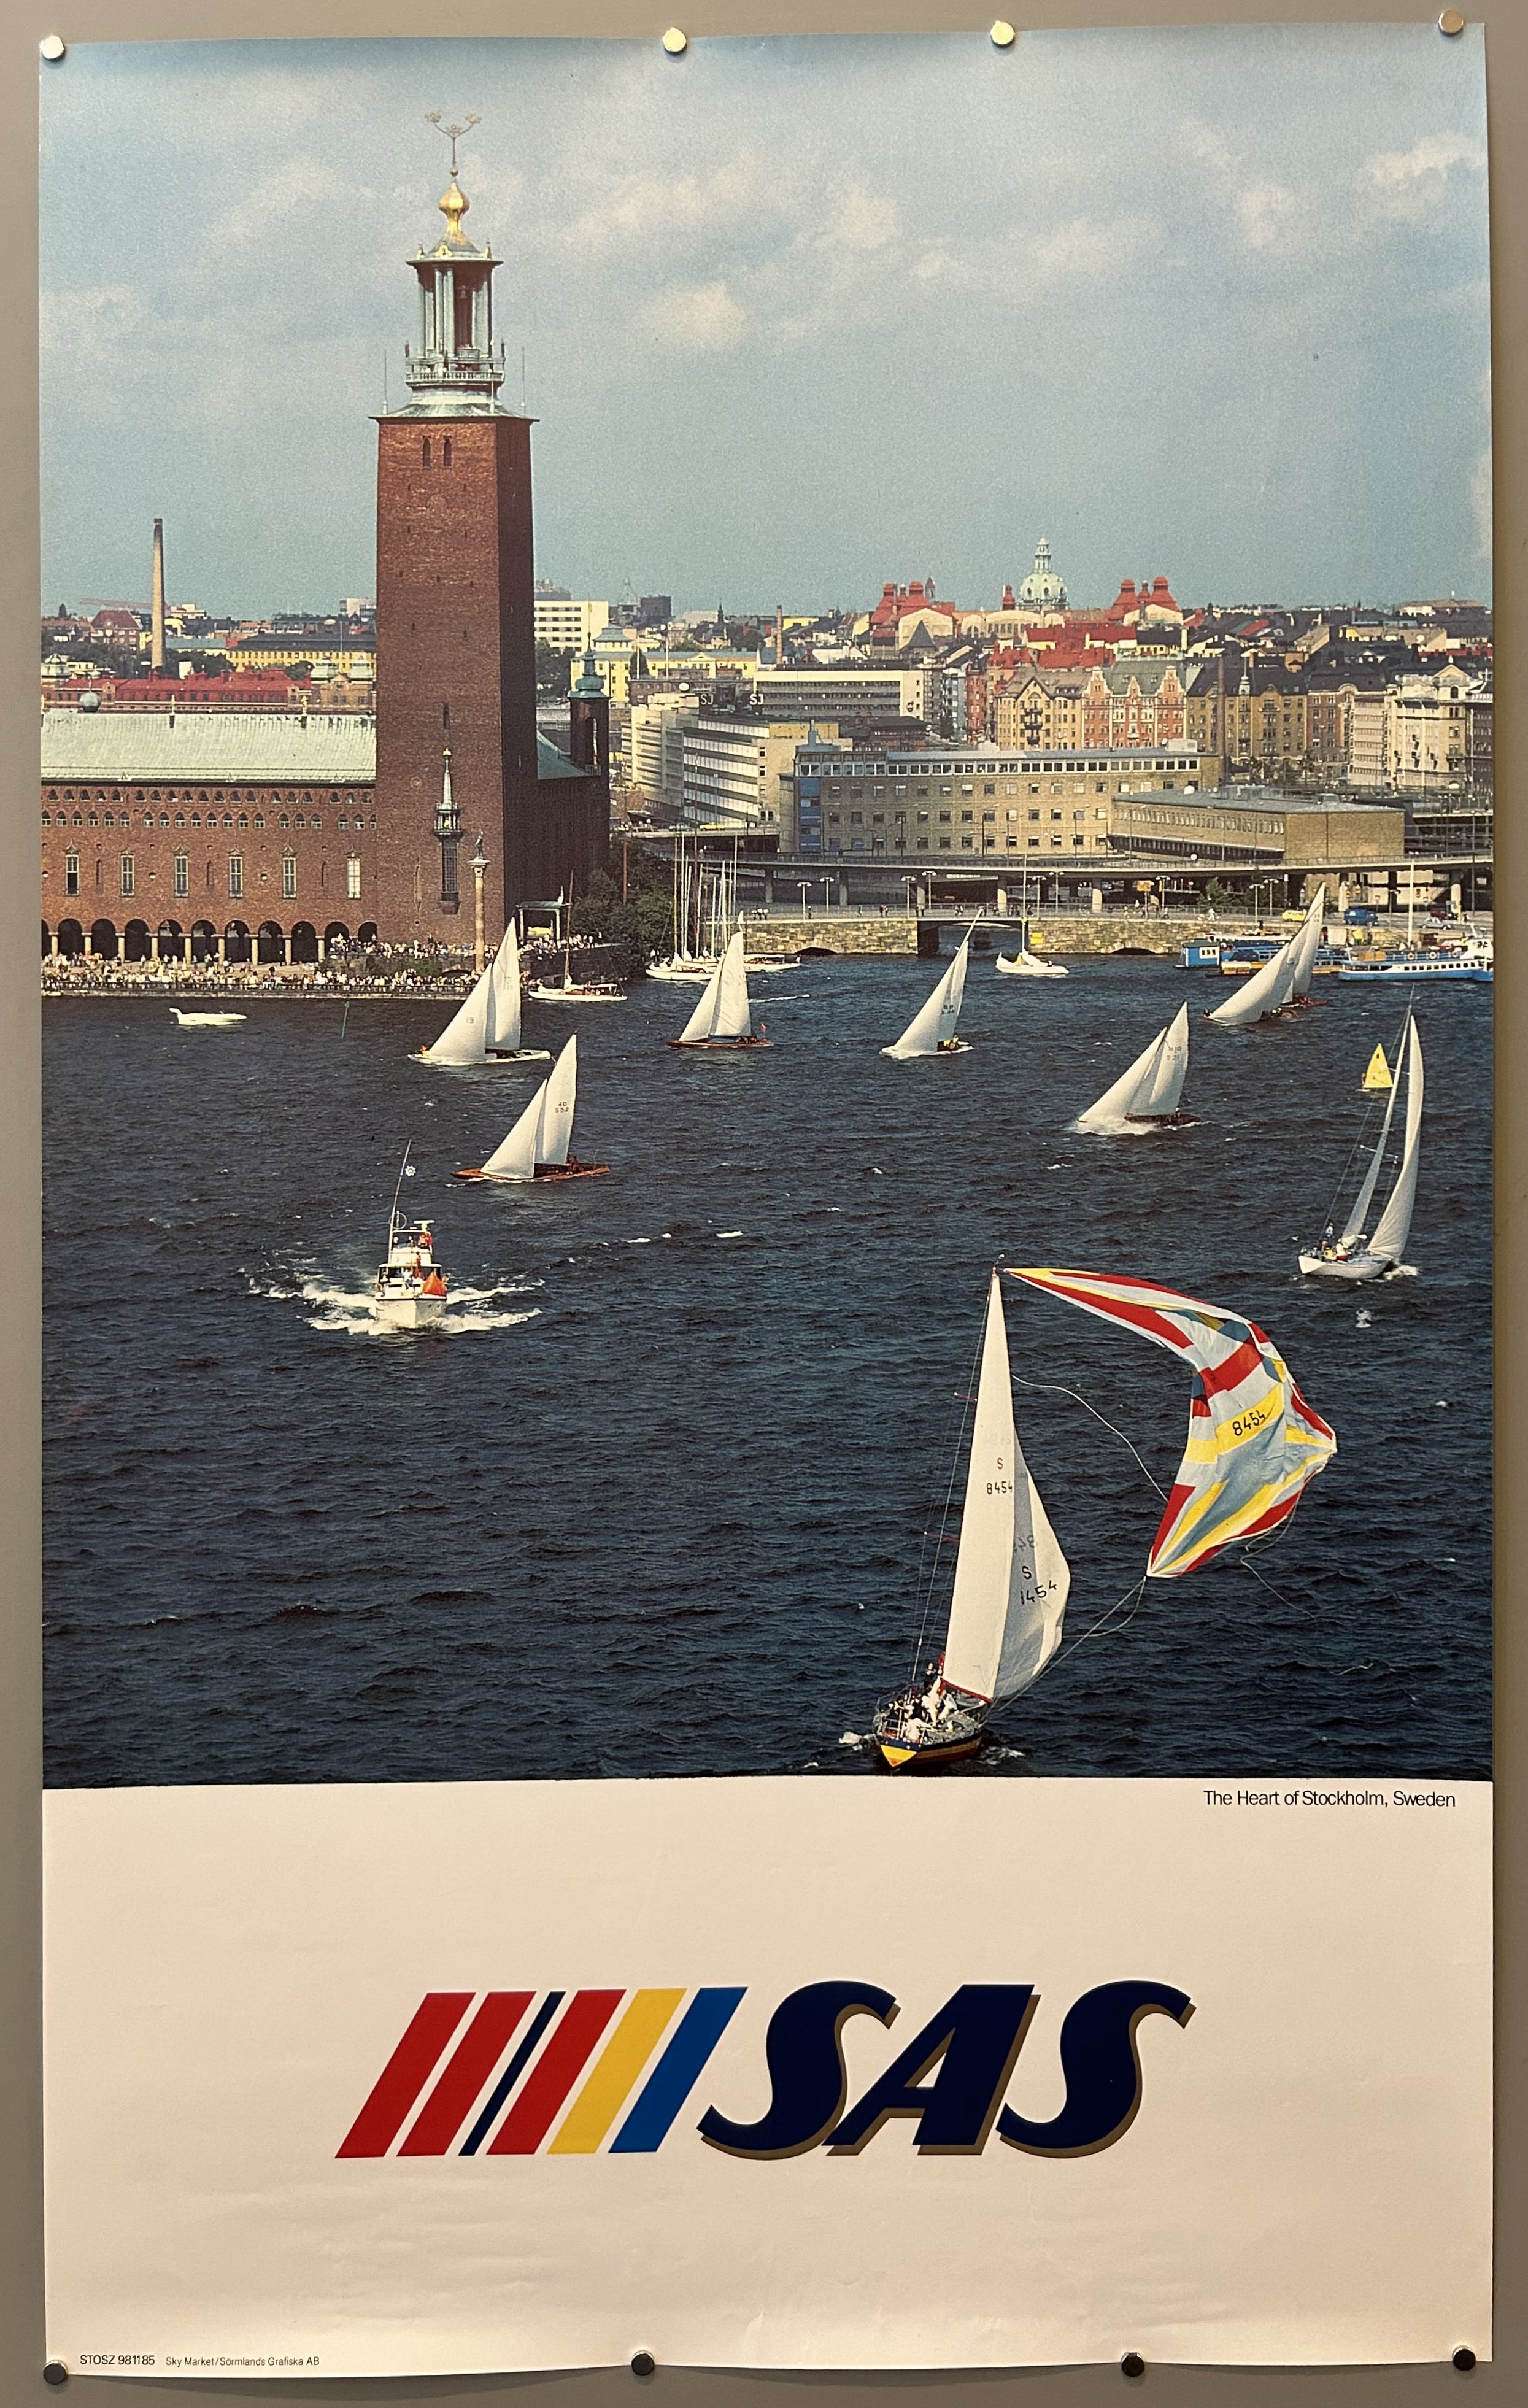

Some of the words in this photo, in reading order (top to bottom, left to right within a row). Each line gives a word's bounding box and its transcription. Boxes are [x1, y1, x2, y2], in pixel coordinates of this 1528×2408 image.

[700, 693, 714, 705] SJ
[749, 693, 764, 705] SJ
[997, 1457, 1003, 1470] S
[986, 1480, 1013, 1495] 8454
[1021, 1565, 1032, 1580] S
[1203, 1790, 1233, 1805] The
[1237, 1790, 1280, 1805] Heart
[1284, 1790, 1300, 1805] of
[1302, 1790, 1388, 1808] Stockholm,
[1393, 1790, 1456, 1807] Sweden
[696, 1980, 1197, 2161] SAS
[80, 2355, 115, 2365] STOSZ
[118, 2355, 155, 2366] 981185
[166, 2357, 182, 2368] Sky
[268, 2356, 304, 2366] Grafiska
[306, 2356, 320, 2366] AB
